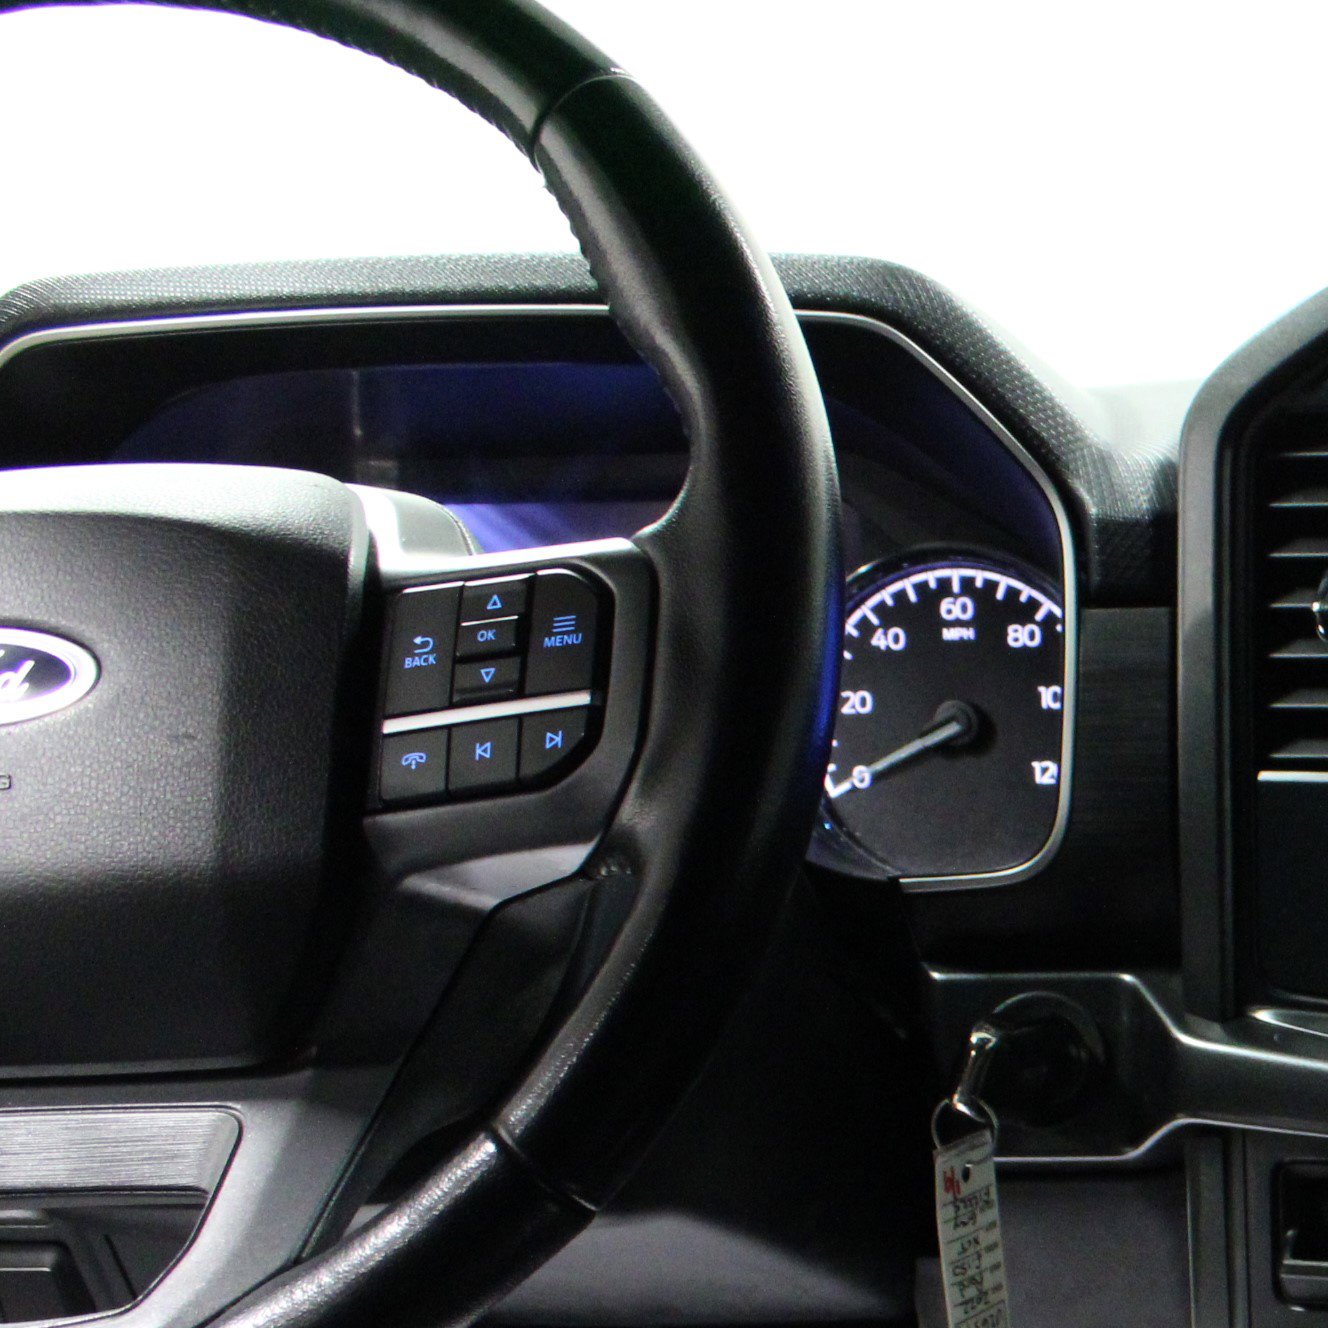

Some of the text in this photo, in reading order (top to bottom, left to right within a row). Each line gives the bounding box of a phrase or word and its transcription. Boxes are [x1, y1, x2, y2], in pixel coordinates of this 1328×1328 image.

[939, 597, 975, 621] 60
[476, 629, 497, 642] OK
[543, 633, 583, 648] MENU
[870, 626, 906, 651] 40
[941, 626, 976, 641] MPH
[1006, 623, 1042, 648] 80
[404, 654, 437, 668] BACK
[841, 690, 873, 714] 20
[1031, 760, 1058, 785] 12
